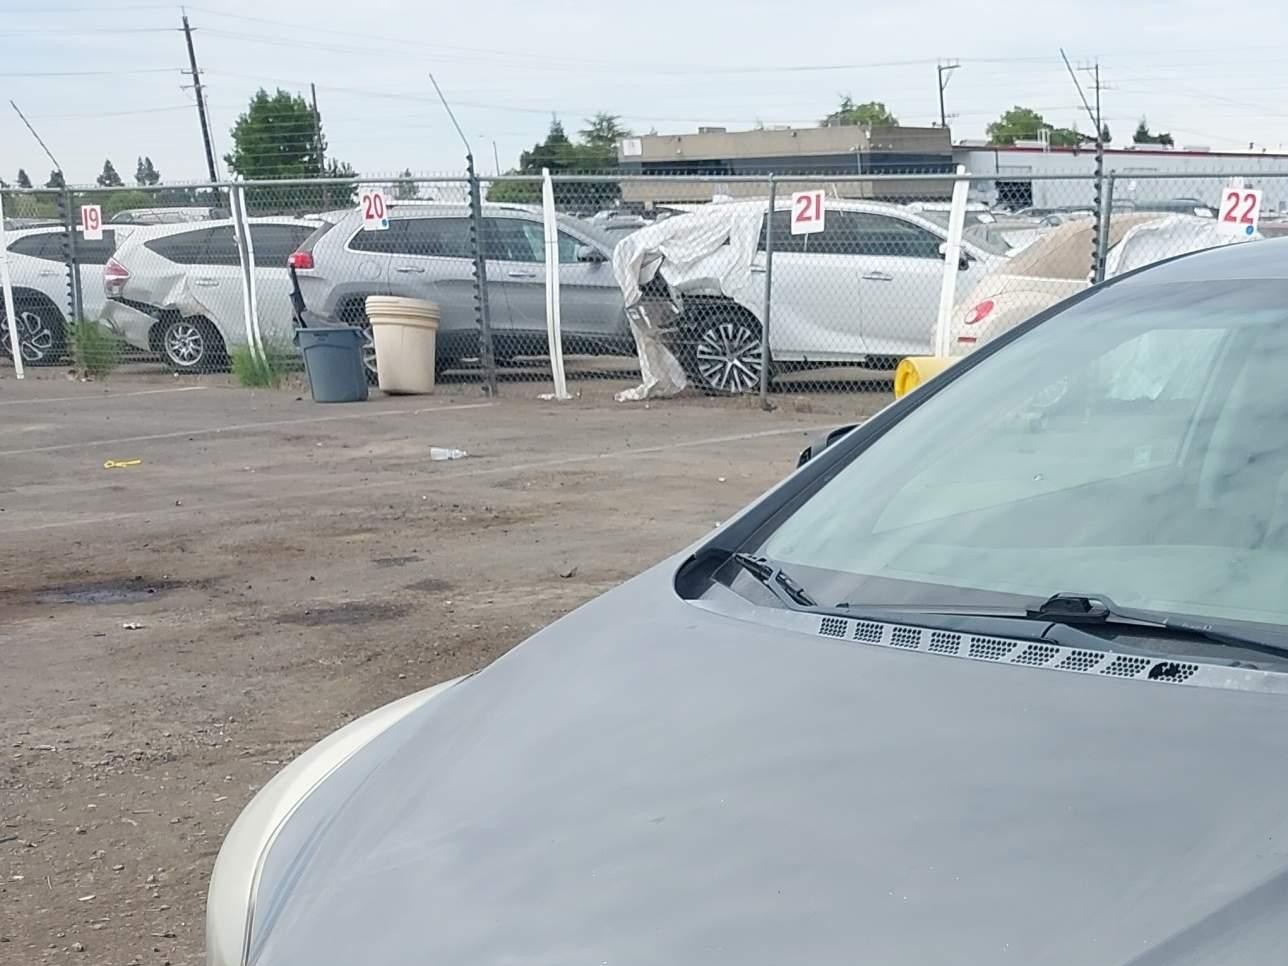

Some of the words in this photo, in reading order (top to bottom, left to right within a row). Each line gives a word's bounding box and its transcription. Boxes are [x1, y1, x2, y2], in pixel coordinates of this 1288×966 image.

[83, 208, 99, 230] 19
[363, 194, 384, 219] 20
[795, 194, 821, 223] 21
[1223, 192, 1257, 224] 22
